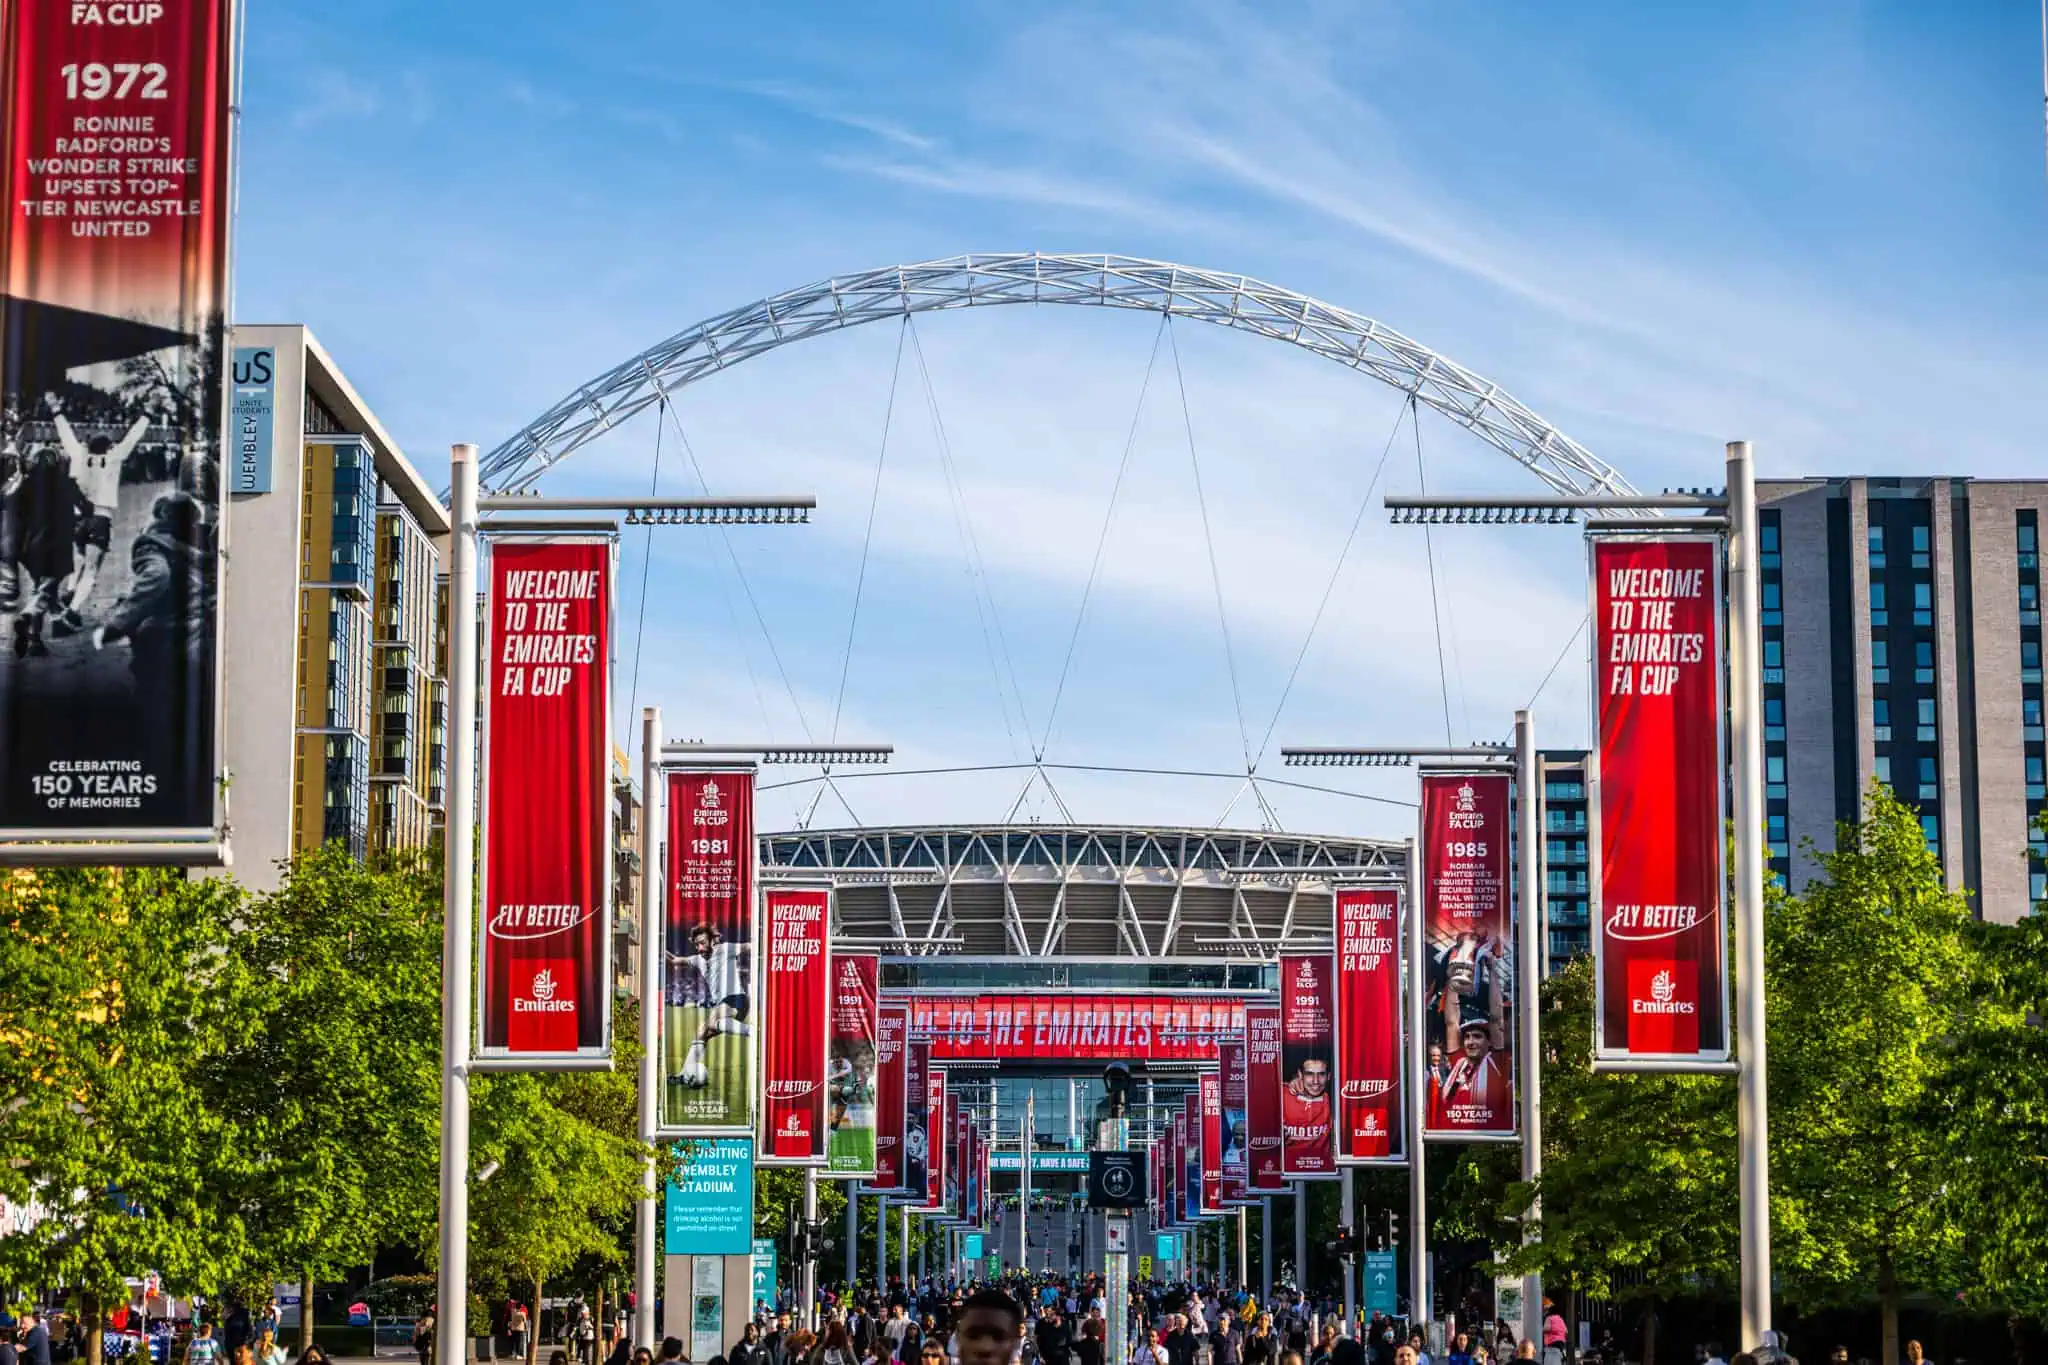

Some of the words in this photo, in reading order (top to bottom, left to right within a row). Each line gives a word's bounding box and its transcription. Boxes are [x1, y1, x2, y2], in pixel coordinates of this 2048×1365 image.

[71, 4, 104, 25] FA
[107, 4, 164, 25] CUP
[61, 63, 168, 100] 1972
[73, 116, 155, 132] RONNIE
[55, 137, 171, 153] RADFORD'S
[27, 158, 121, 175] WONDER
[126, 158, 198, 174] STRIKE
[45, 179, 122, 195] UPSETS
[126, 179, 179, 195] TOP-
[20, 200, 68, 216] TIER
[74, 200, 201, 216] NEWCASTLE
[71, 221, 150, 237] UNITED
[241, 416, 257, 490] WEMBLEY
[505, 570, 600, 599] WELCOME
[1610, 569, 1704, 598] WELCOME
[505, 602, 528, 631] TO
[534, 602, 570, 631] THE
[1610, 601, 1633, 630] TO
[1640, 601, 1675, 630] THE
[502, 634, 597, 664] EMIRATES
[1610, 633, 1704, 663] EMIRATES
[502, 666, 525, 696] FA
[530, 666, 572, 696] CUP
[1610, 665, 1633, 695] FA
[1640, 665, 1680, 695] CUP
[49, 761, 142, 772] CELEBRATING
[32, 776, 73, 794] 150
[78, 776, 158, 794] YEARS
[48, 797, 65, 808] OF
[70, 797, 142, 808] MEMORIES
[694, 817, 706, 826] FA
[707, 817, 728, 826] CUP
[1449, 820, 1463, 829] FA
[1464, 820, 1484, 829] CUP
[691, 840, 729, 854] 1981
[1446, 843, 1487, 857] 1985
[498, 905, 524, 927] FLY
[526, 905, 580, 927] BETTER
[772, 904, 822, 920] WELCOME
[1343, 903, 1393, 919] WELCOME
[1614, 905, 1641, 927] FLY
[1643, 905, 1697, 928] BETTER
[772, 921, 785, 937] TO
[788, 921, 807, 937] THE
[1343, 921, 1355, 936] TO
[1359, 921, 1378, 937] THE
[771, 939, 821, 955] EMIRATES
[1343, 938, 1392, 954] EMIRATES
[771, 955, 783, 971] FA
[786, 955, 807, 971] CUP
[1343, 955, 1355, 971] FA
[1359, 955, 1380, 971] CUP
[513, 998, 575, 1012] Emirates
[839, 995, 862, 1005] 1991
[1296, 996, 1319, 1006] 1991
[1632, 999, 1694, 1013] Emirates
[948, 1011, 975, 1045] TO
[984, 1011, 1028, 1045] THE
[1034, 1011, 1153, 1046] EMIRATES
[769, 1080, 782, 1092] FLY
[784, 1080, 812, 1092] BETTER
[1345, 1080, 1358, 1092] FLY
[1360, 1080, 1389, 1092] BETTER
[1446, 1110, 1462, 1118] 150
[1463, 1110, 1493, 1118] YEARS
[777, 1129, 809, 1137] Emirates
[1354, 1129, 1387, 1137] Emirates
[680, 1165, 738, 1176] WEMBLEY
[1040, 1157, 1060, 1168] HAVE
[700, 1214, 723, 1222] alcohol
